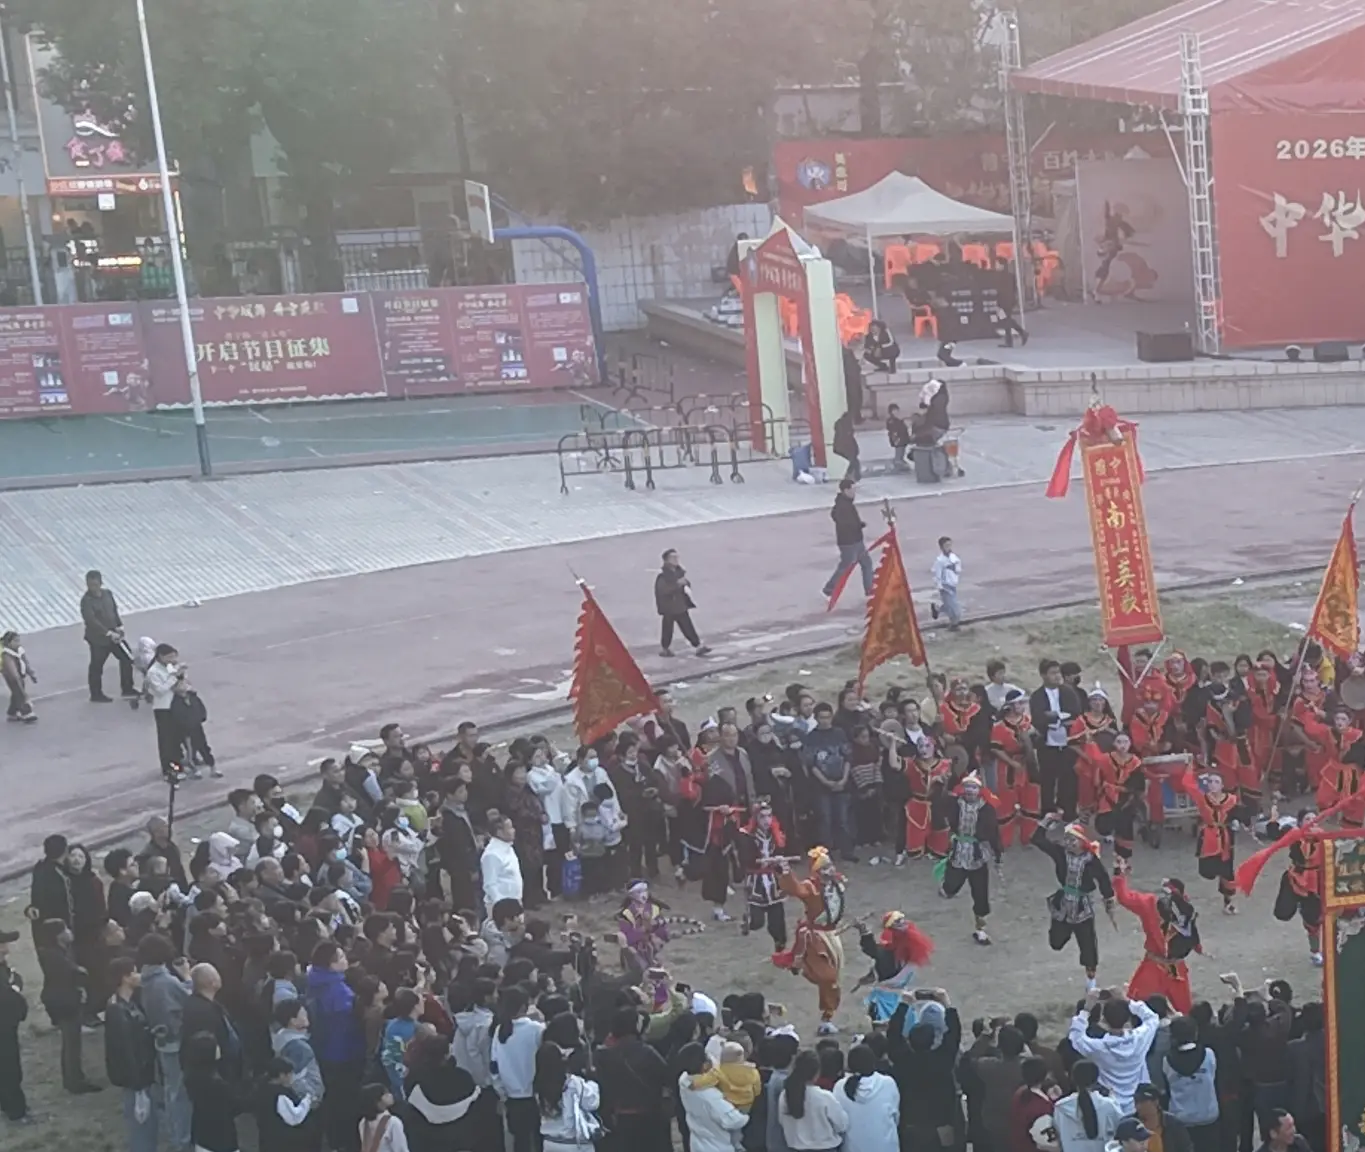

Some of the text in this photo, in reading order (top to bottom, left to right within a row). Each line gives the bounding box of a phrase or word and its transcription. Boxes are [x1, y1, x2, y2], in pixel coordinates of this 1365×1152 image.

[196, 336, 330, 362] 开启节目征集
